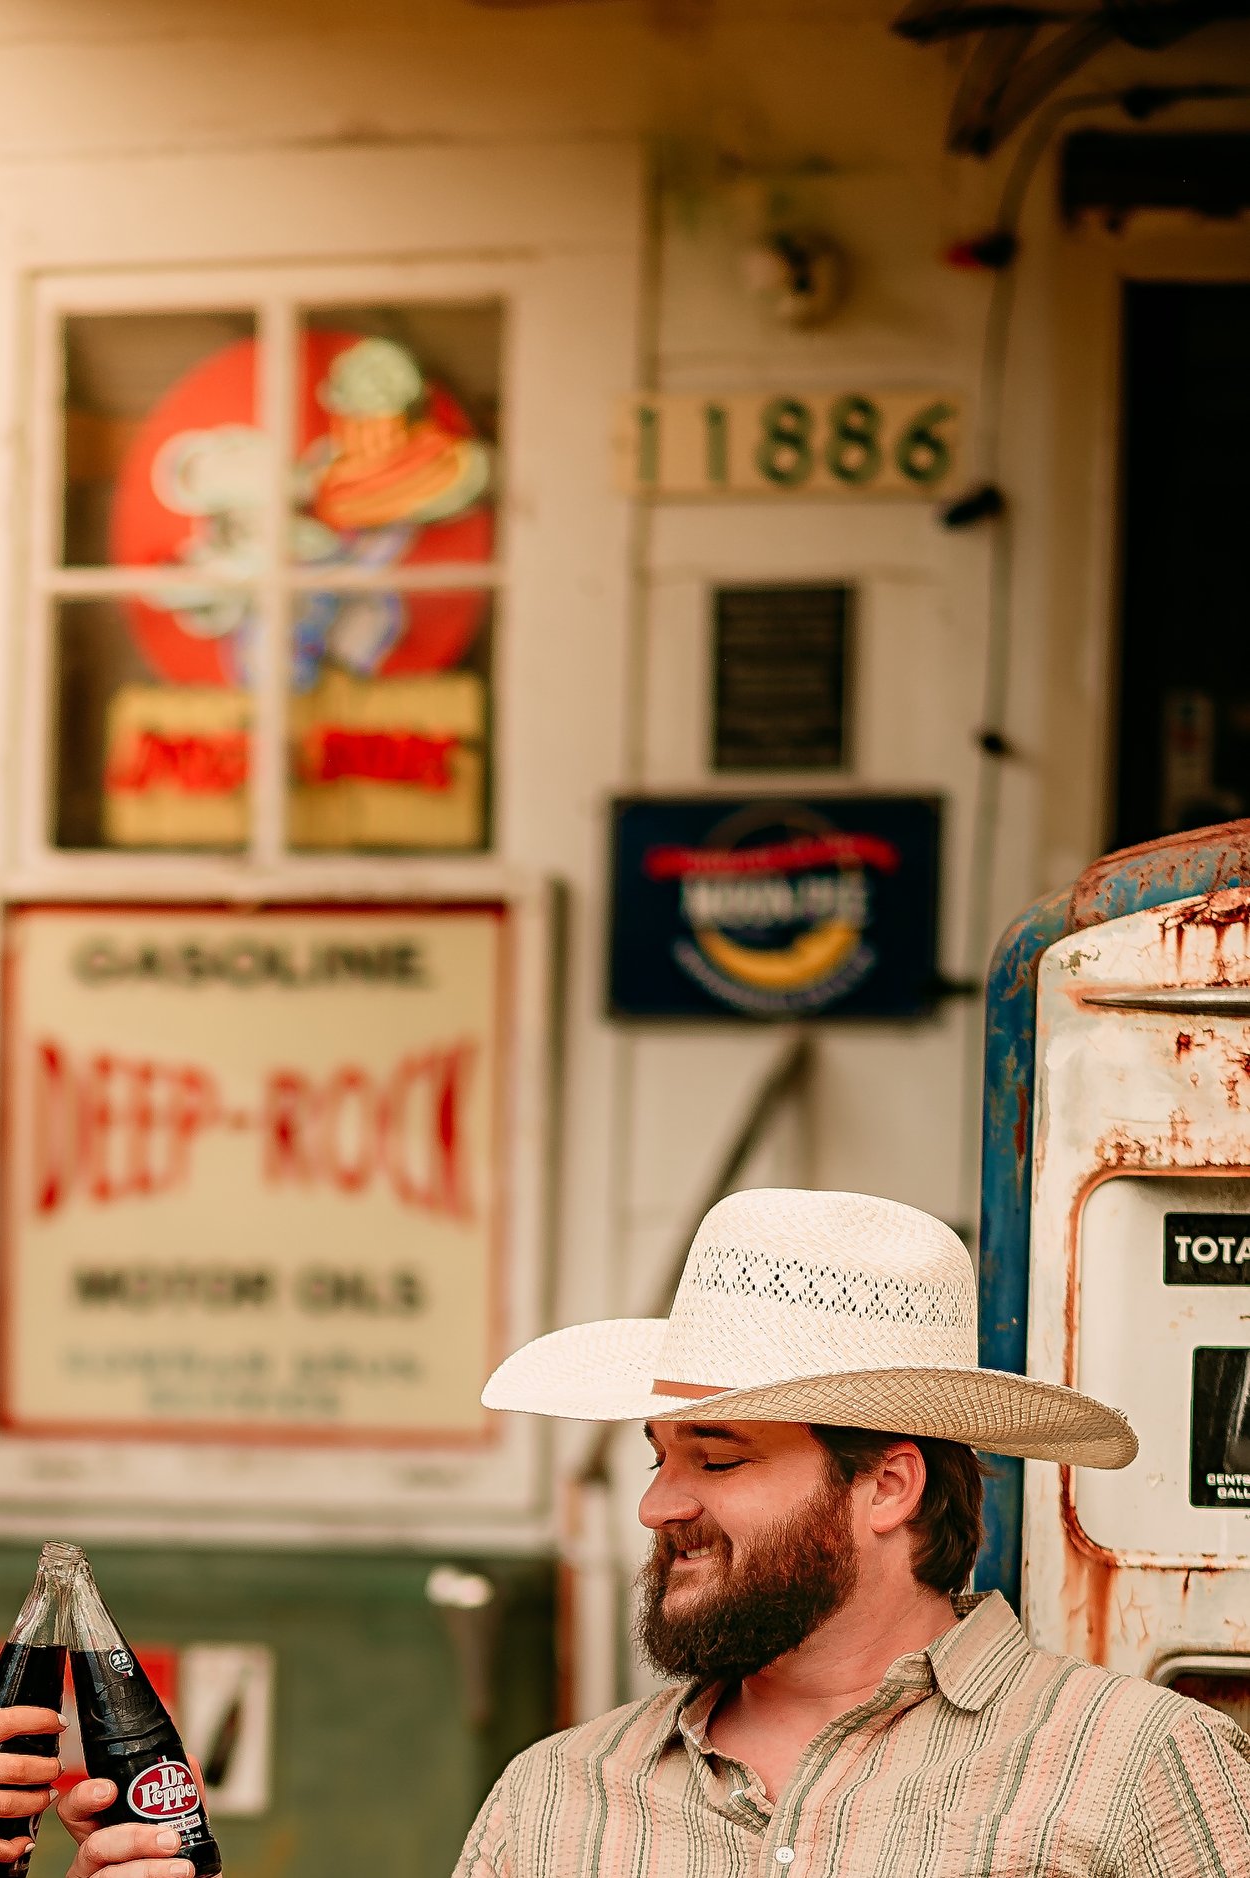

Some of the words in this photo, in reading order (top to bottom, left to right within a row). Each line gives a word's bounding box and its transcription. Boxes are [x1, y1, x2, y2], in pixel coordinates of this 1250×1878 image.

[636, 394, 957, 487] 11886
[73, 937, 432, 988] GASOLINE
[33, 1034, 479, 1228] DEEP-ROCK
[72, 1261, 274, 1312] MOTOR
[297, 1262, 430, 1316] OILS
[111, 1652, 129, 1667] 23
[138, 1782, 197, 1813] Pepper
[157, 1766, 186, 1791] Dr
